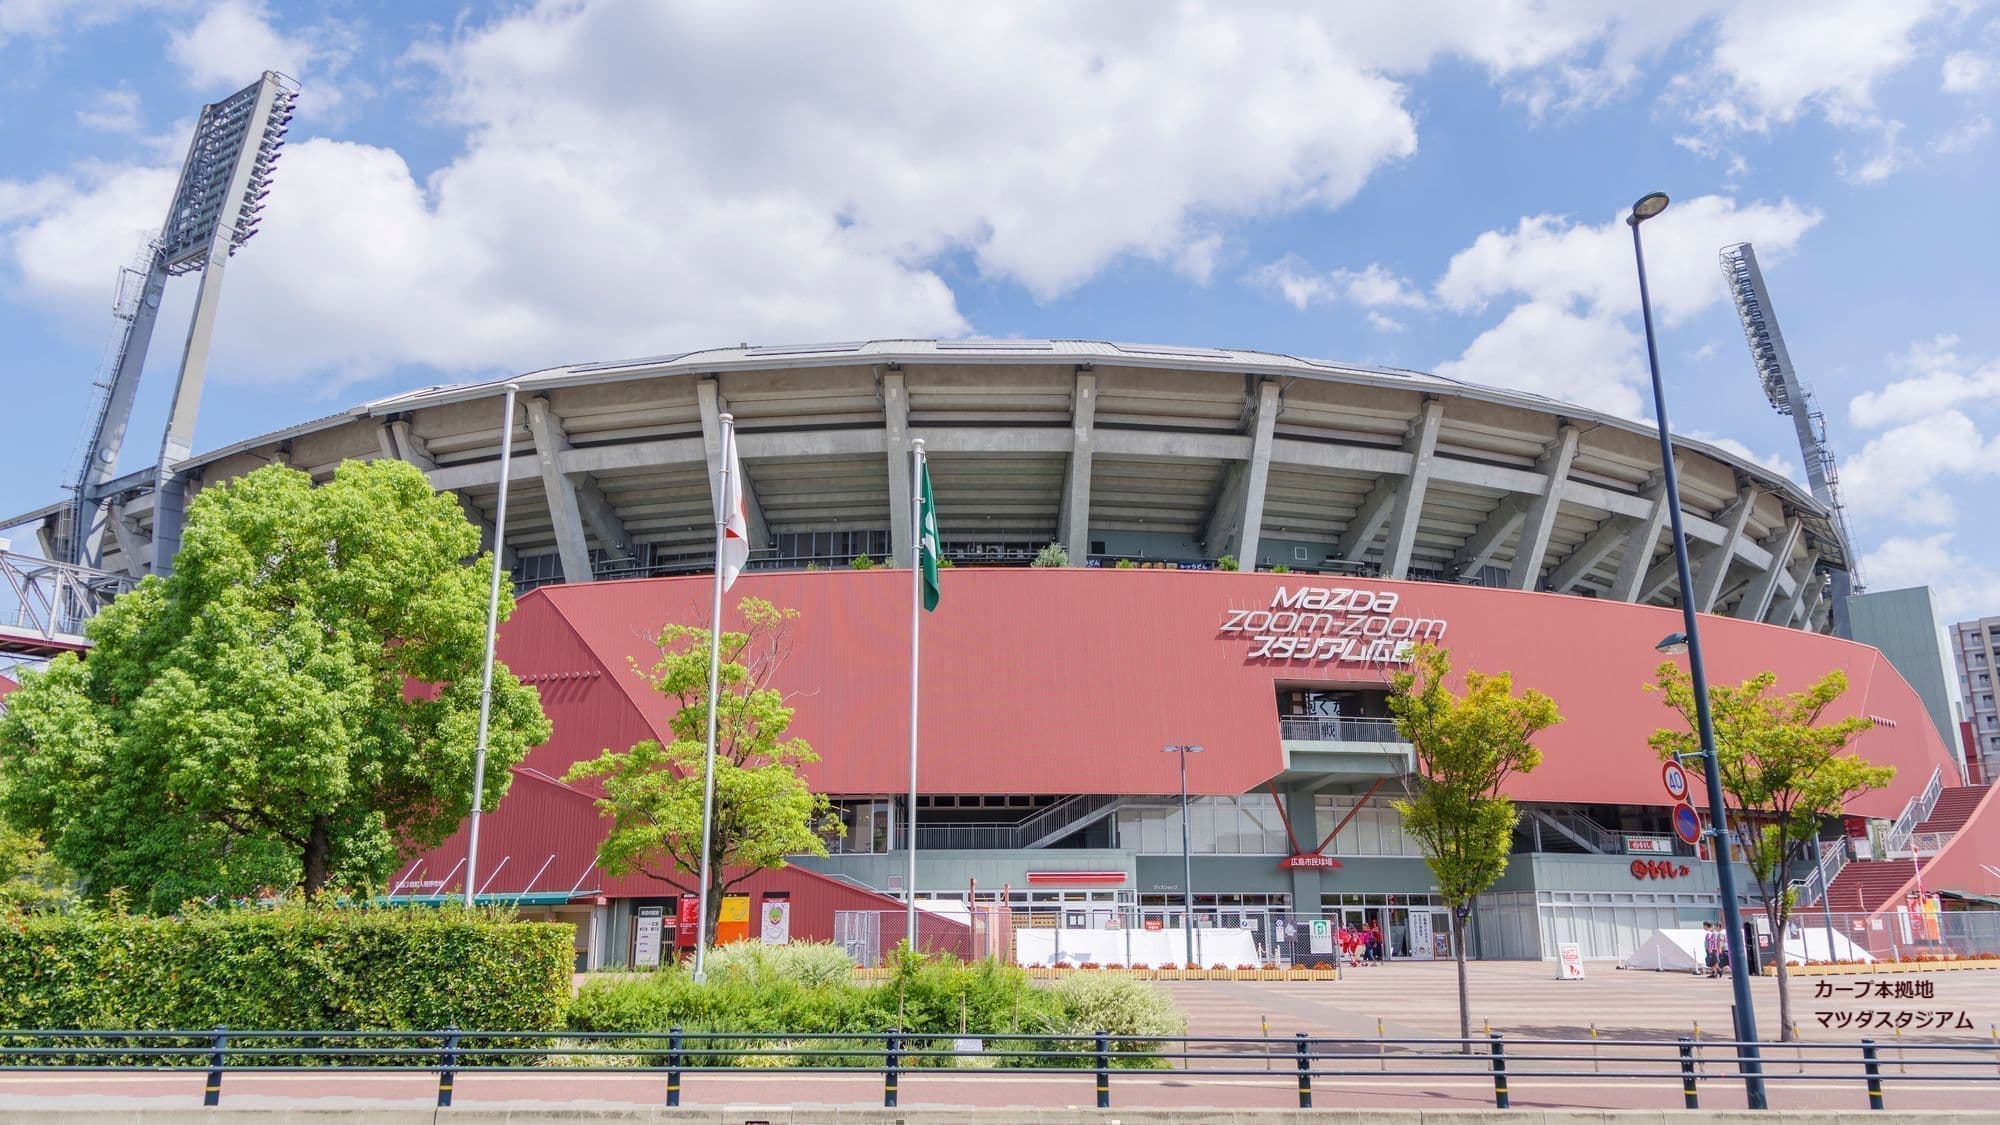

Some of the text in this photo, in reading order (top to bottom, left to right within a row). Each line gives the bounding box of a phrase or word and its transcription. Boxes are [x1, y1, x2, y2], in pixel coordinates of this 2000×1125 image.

[1248, 635, 1416, 663] スタジアム広島
[1669, 771, 1683, 790] 40
[1291, 857, 1333, 867] 広島市民球場
